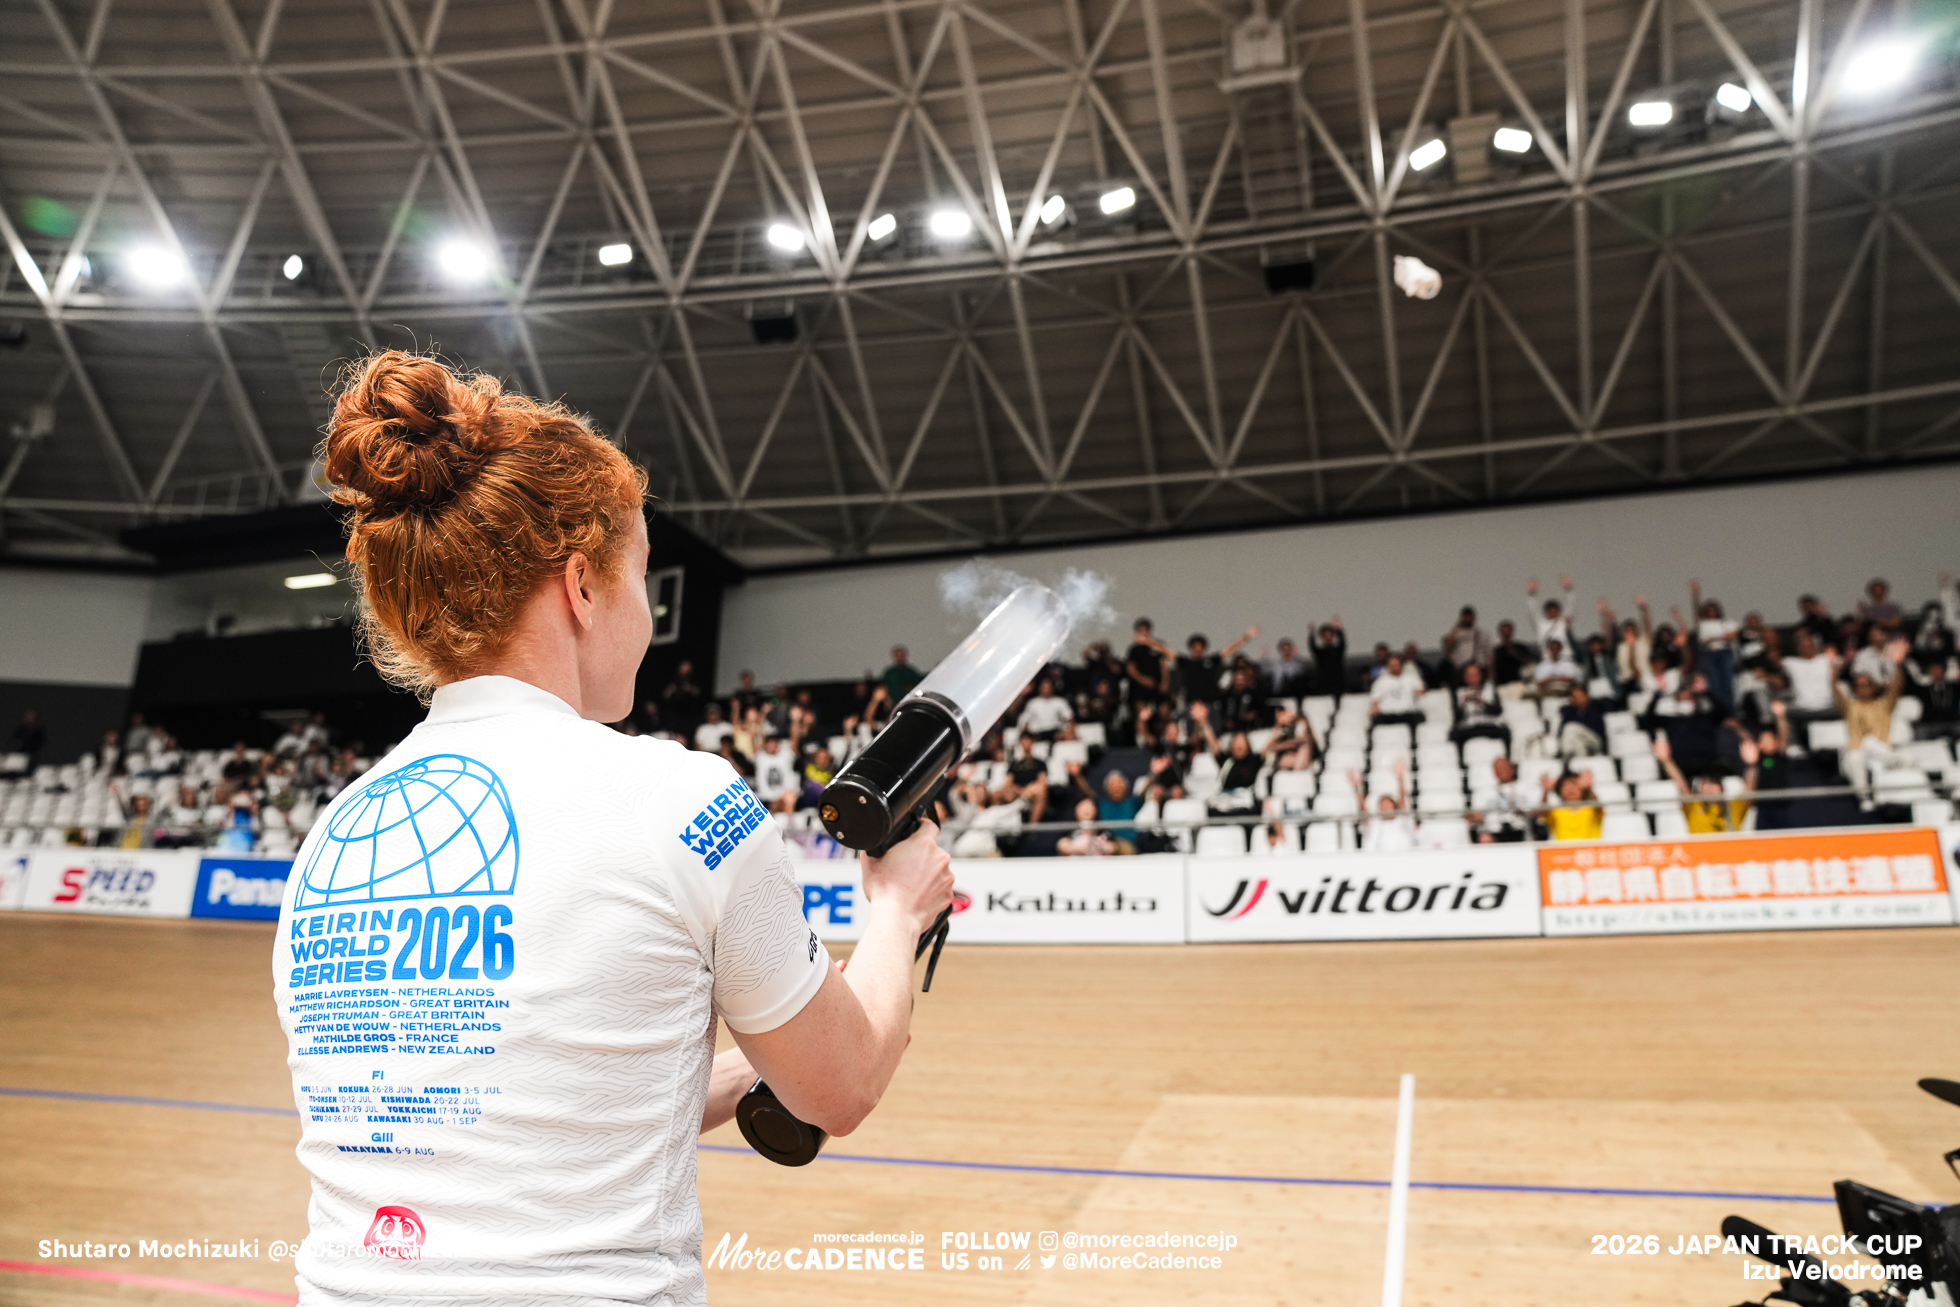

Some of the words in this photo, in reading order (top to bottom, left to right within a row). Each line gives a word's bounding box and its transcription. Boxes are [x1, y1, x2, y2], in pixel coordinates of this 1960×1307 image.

[678, 780, 745, 846] KEIRIN
[691, 793, 755, 856] WORLD
[704, 806, 766, 871] SERIES
[1278, 871, 1509, 914] vittoria
[987, 890, 1158, 912] Kabuto
[291, 909, 393, 940] KEIRIN
[291, 935, 390, 963] WORLD
[392, 904, 514, 981] 2026
[289, 960, 387, 988] SERIES
[294, 991, 323, 1003] HARRIE
[324, 988, 389, 1000] LAVREYSEN
[398, 988, 495, 997] NETHERLANDS
[289, 1002, 325, 1014] MATTHEW
[326, 1000, 400, 1010] RICHARDSON
[409, 1000, 451, 1008] GREAT
[453, 1000, 510, 1009] BRITAIN
[299, 1012, 330, 1023] JOSEPH
[331, 1011, 379, 1020] TRUMAN
[389, 1011, 428, 1020] GREAT
[431, 1011, 485, 1020] BRITAIN
[294, 1025, 315, 1034] HETTY
[316, 1024, 334, 1033] VAN
[336, 1024, 350, 1032] DE
[352, 1022, 390, 1031] WOUW
[400, 1022, 502, 1032] NETHERLANDS
[313, 1034, 362, 1043] MATHILDE
[363, 1034, 396, 1042] GROS
[406, 1034, 459, 1043] FRANCE
[297, 1047, 330, 1056] ELLESSE
[331, 1045, 389, 1054] ANDREWS
[399, 1045, 425, 1054] NEW
[429, 1046, 495, 1055] ZEALAND
[372, 1086, 394, 1094] 26-28
[396, 1086, 413, 1094] JUN
[423, 1086, 461, 1094] AOMORI
[464, 1086, 480, 1095] 3-5
[483, 1086, 502, 1095] JUL
[380, 1096, 431, 1104] KISHIWADA
[433, 1096, 459, 1104] 20-22
[462, 1096, 480, 1105] JUL
[364, 1105, 379, 1113] JUL
[387, 1106, 436, 1114] YOKKAICHI
[438, 1106, 459, 1115] 17-19
[462, 1107, 482, 1115] AUG
[344, 1115, 359, 1123] AUG
[367, 1115, 411, 1123] KAWASAKI
[413, 1116, 424, 1124] 30
[426, 1116, 444, 1124] AUG
[459, 1117, 477, 1125] SEP
[337, 1145, 393, 1154] WAKAYAMA
[395, 1146, 411, 1155] 6-9
[415, 1147, 434, 1156] AUG
